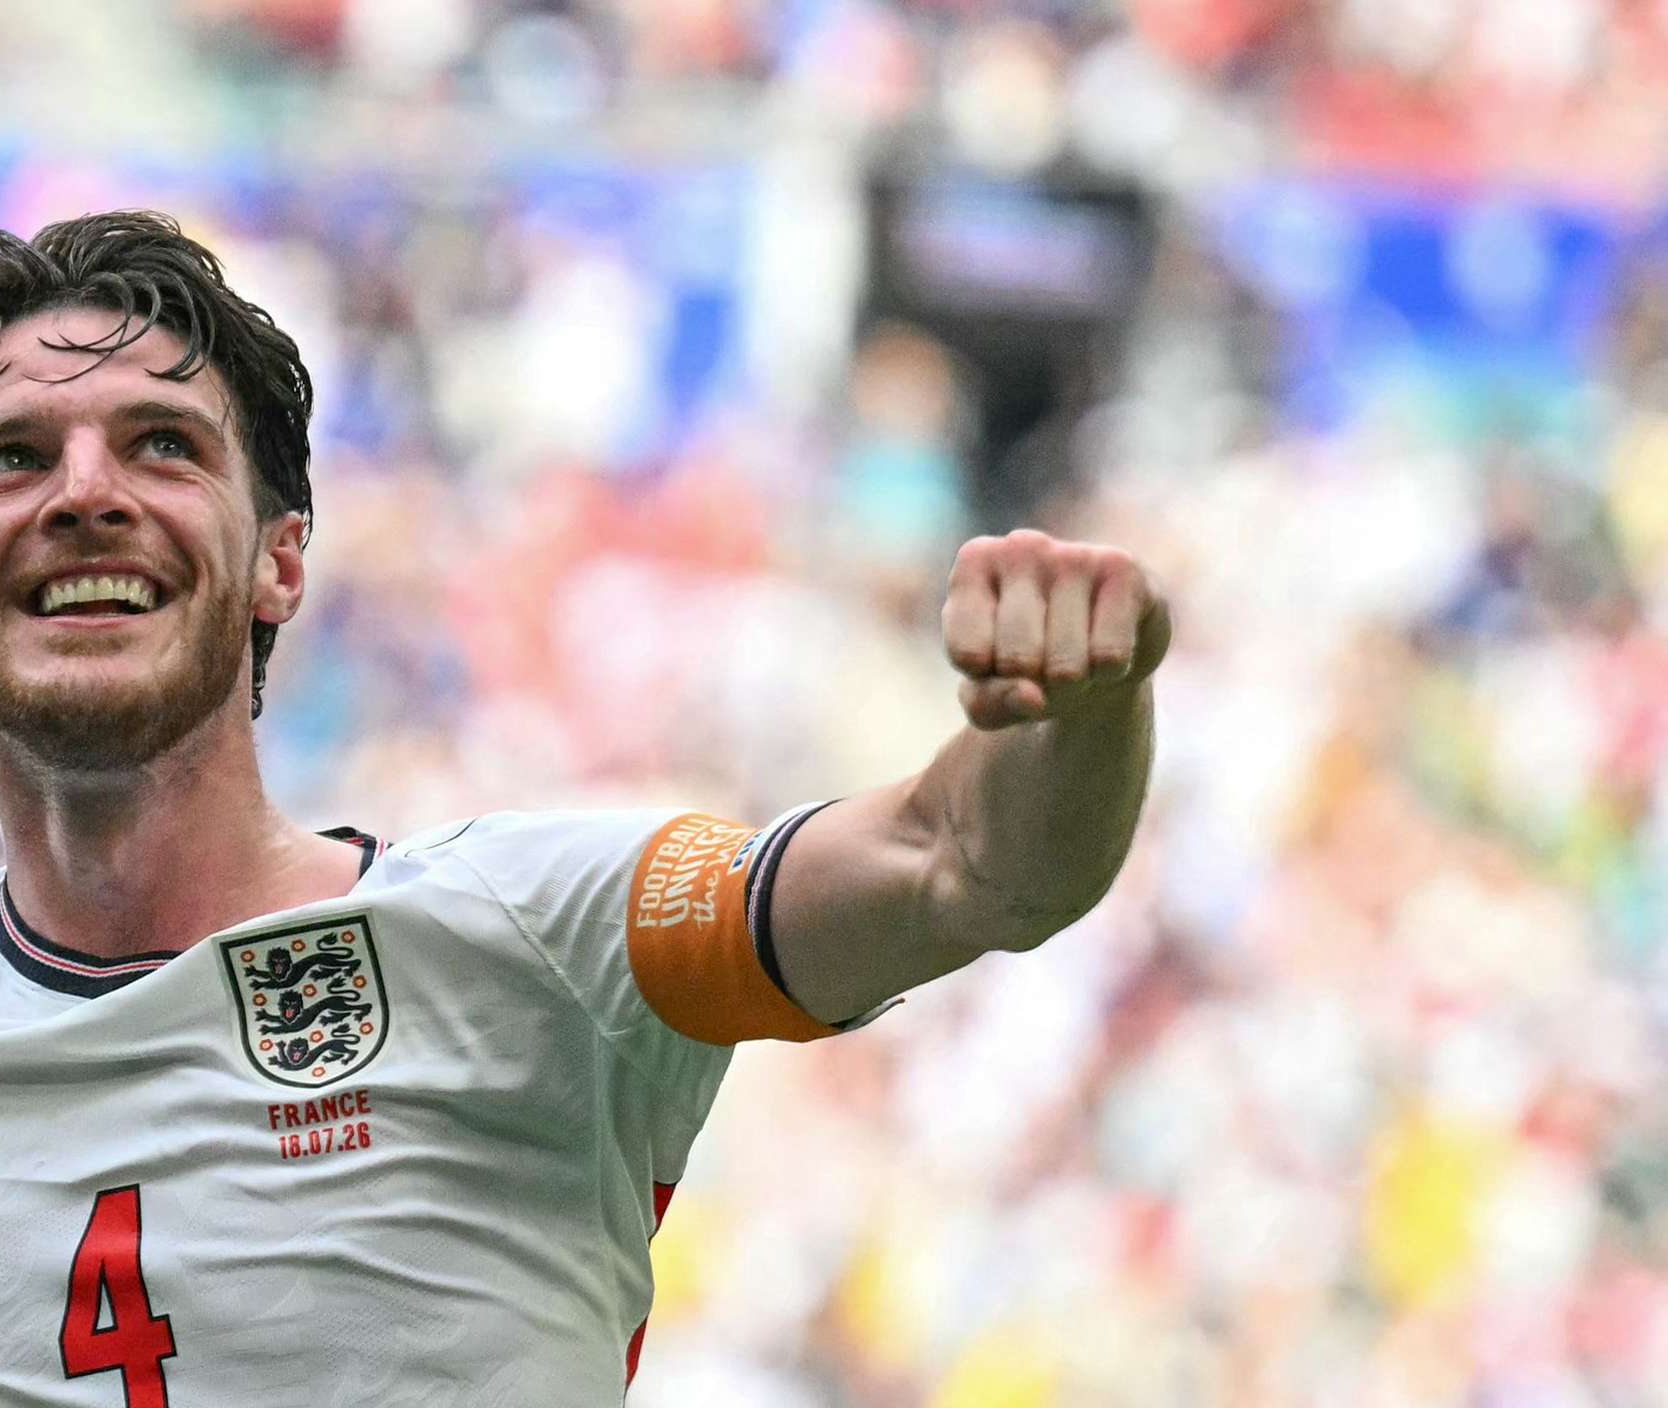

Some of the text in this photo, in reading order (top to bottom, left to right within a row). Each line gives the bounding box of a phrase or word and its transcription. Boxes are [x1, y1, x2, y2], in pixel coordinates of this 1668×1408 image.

[636, 818, 716, 928] FOOTBALL
[268, 1089, 371, 1130] FRANCE
[280, 1122, 371, 1160] 18.07.26
